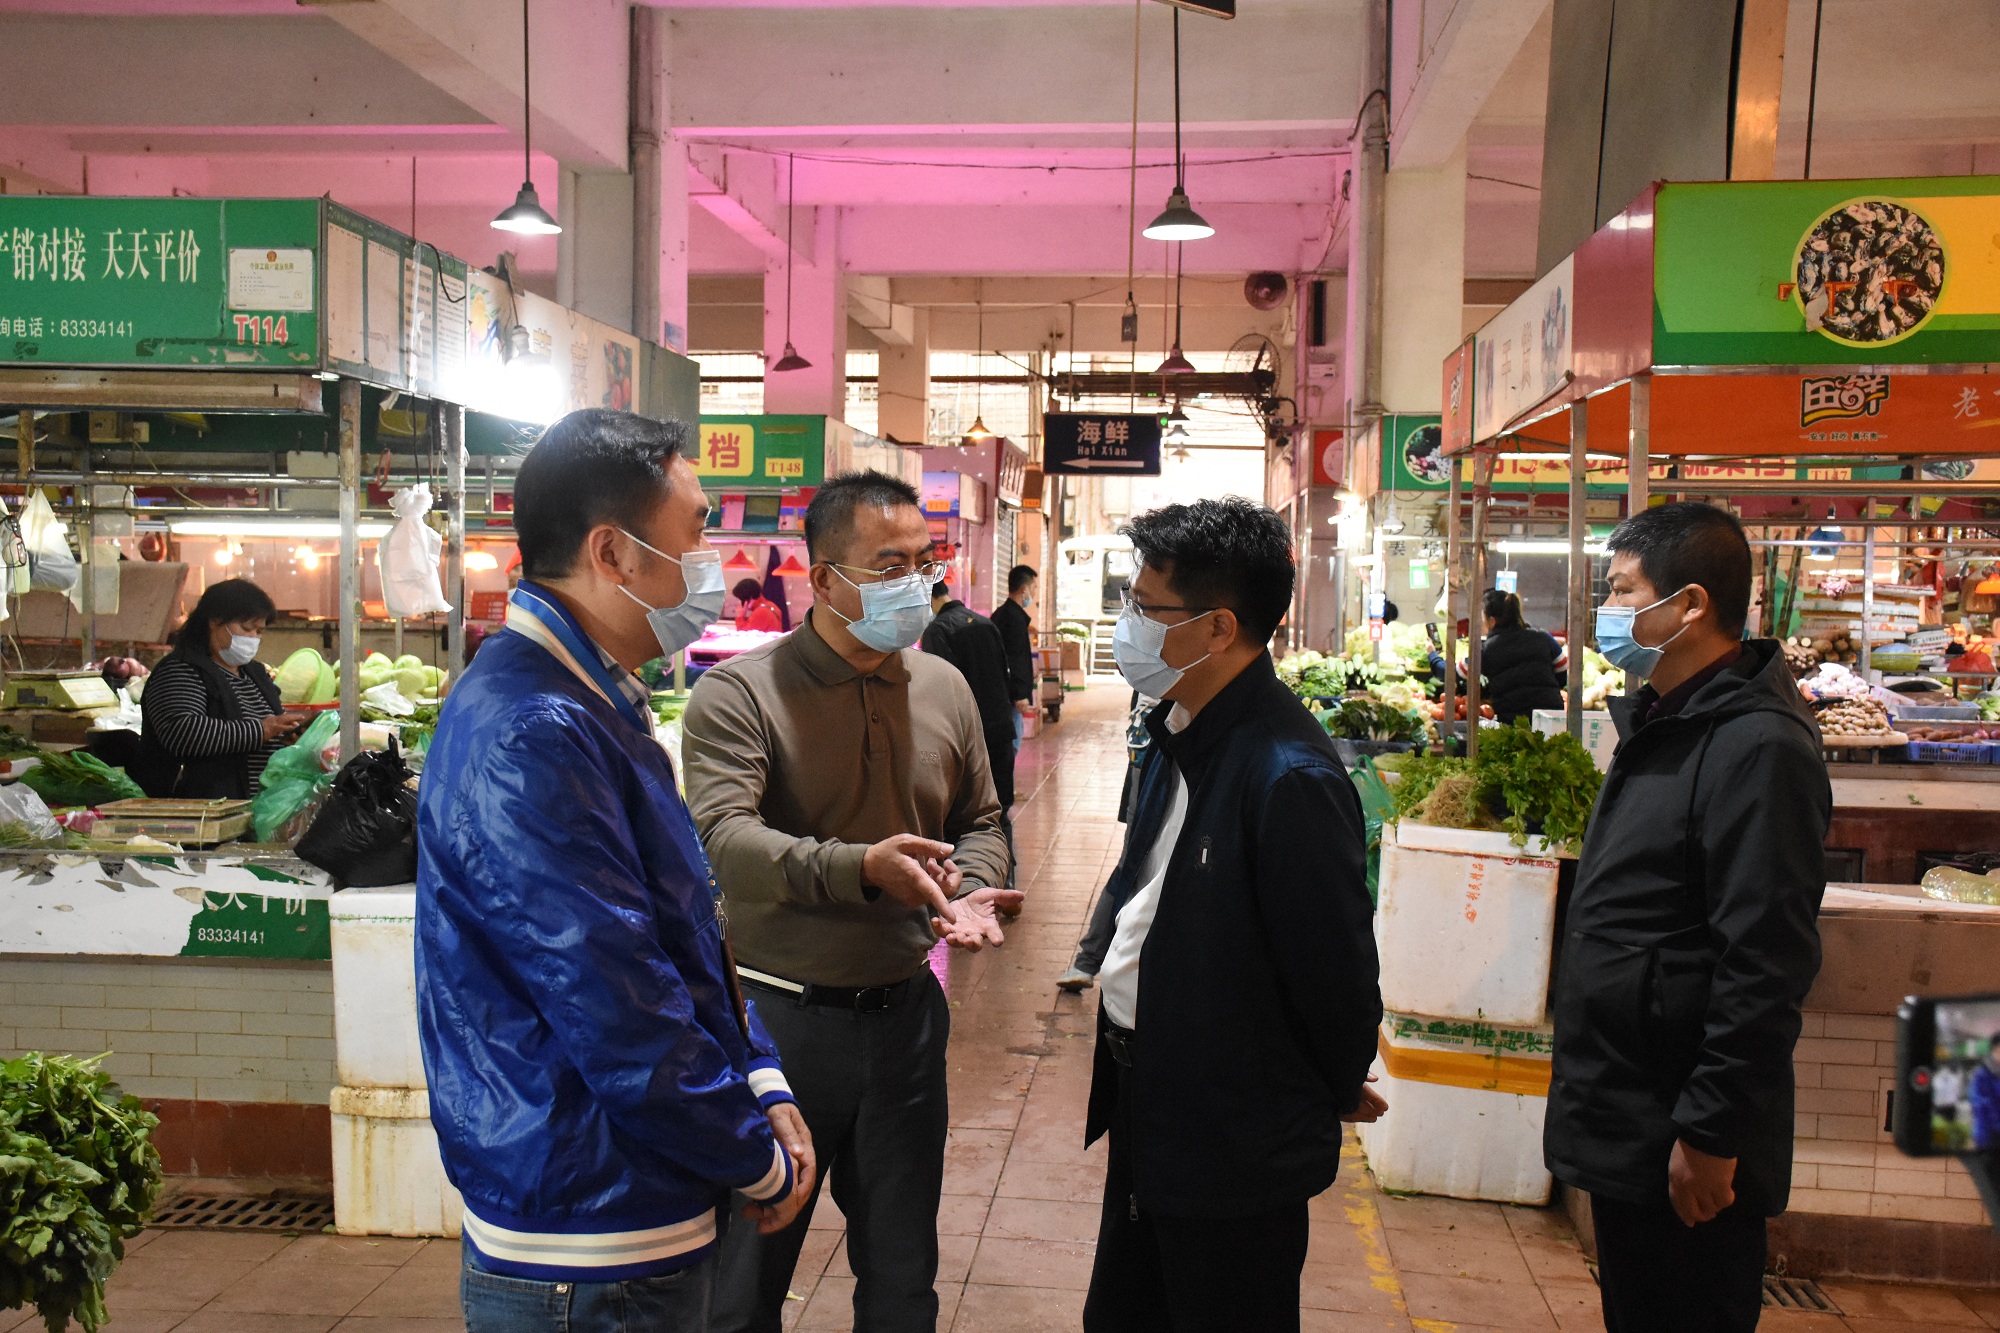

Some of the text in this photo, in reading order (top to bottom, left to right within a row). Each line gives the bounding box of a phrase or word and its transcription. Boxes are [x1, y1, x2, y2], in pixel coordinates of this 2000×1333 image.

[101, 228, 201, 283] 天天平价
[233, 314, 289, 345] T114
[1953, 386, 2000, 419] 老
[1077, 420, 1129, 444] 海鲜
[1077, 446, 1127, 456] Hai Xian
[769, 462, 801, 473] T148
[198, 927, 265, 944] 83334141
